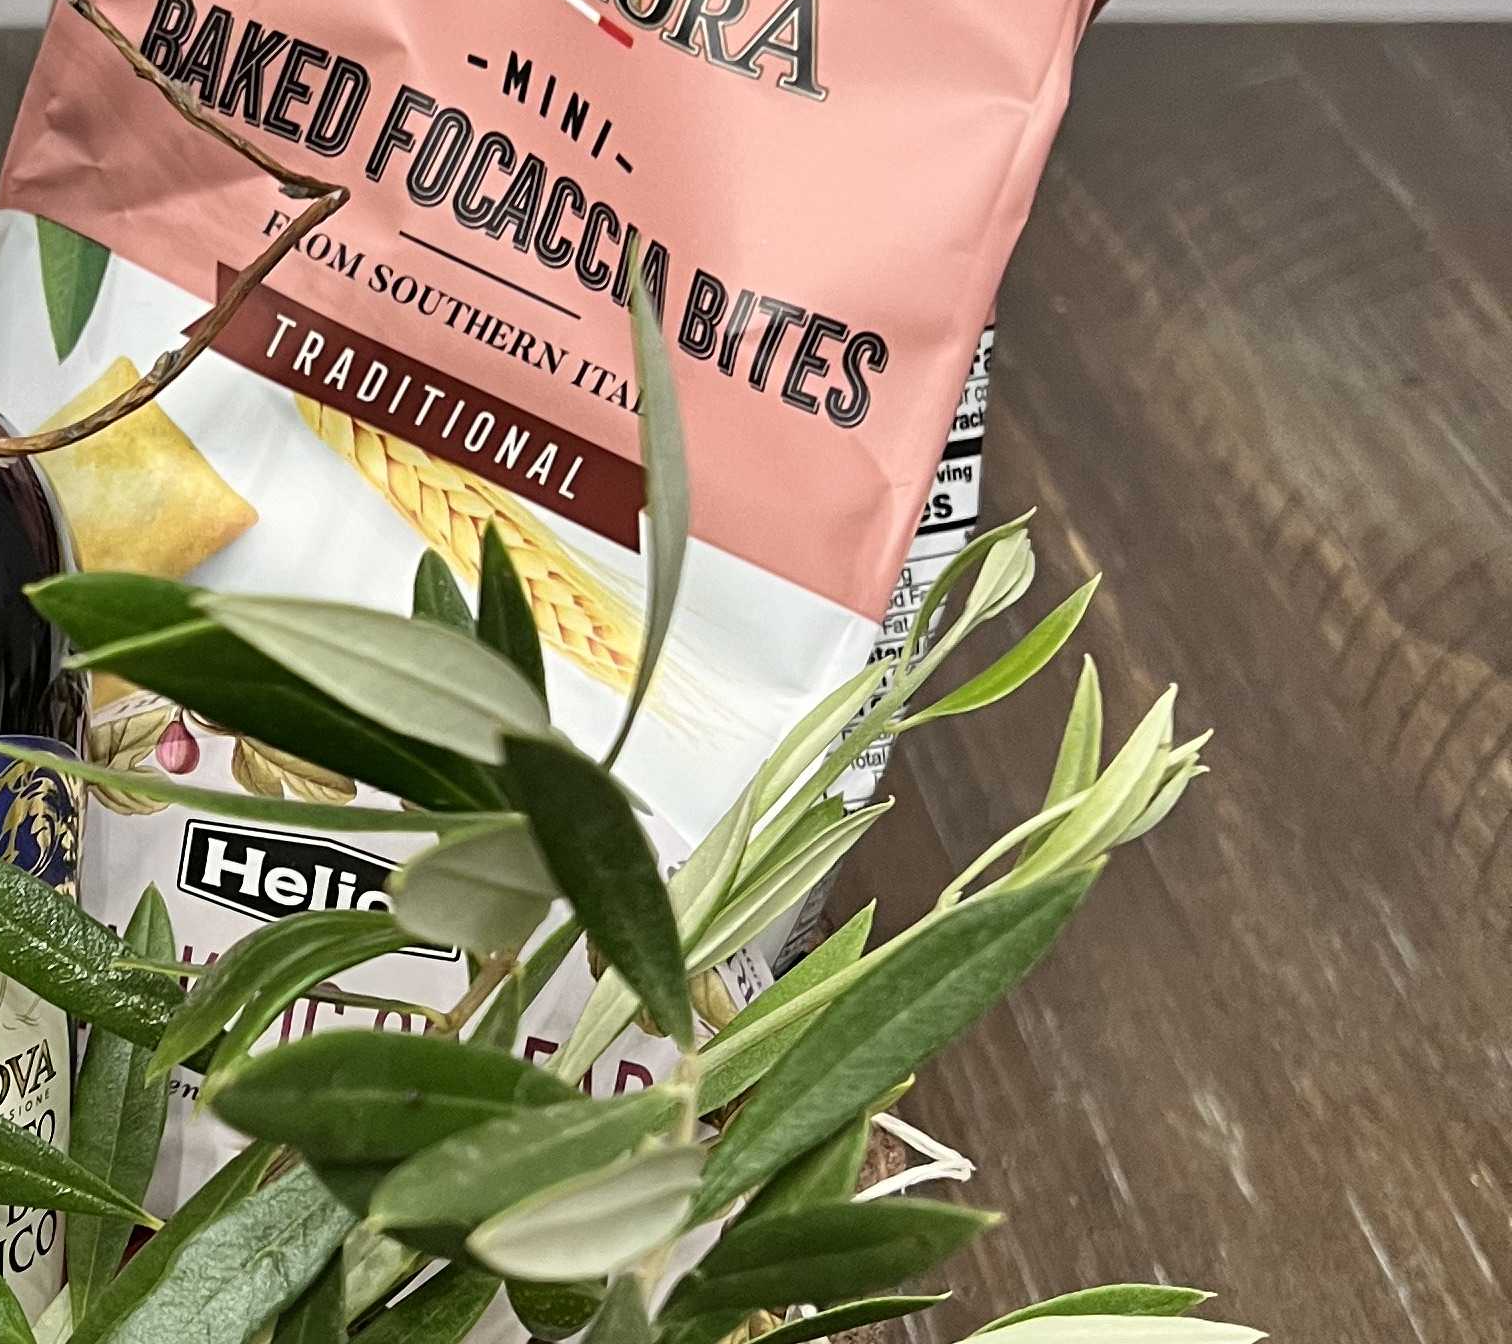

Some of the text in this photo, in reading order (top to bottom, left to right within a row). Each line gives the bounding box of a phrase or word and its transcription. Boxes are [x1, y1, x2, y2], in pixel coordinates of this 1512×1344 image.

[261, 208, 367, 280] FOM
[368, 262, 569, 376] SOUTHERN
[364, 84, 672, 332] FOCACCIA
[676, 267, 889, 430] BITES
[266, 312, 585, 501] TRADITIONAL
